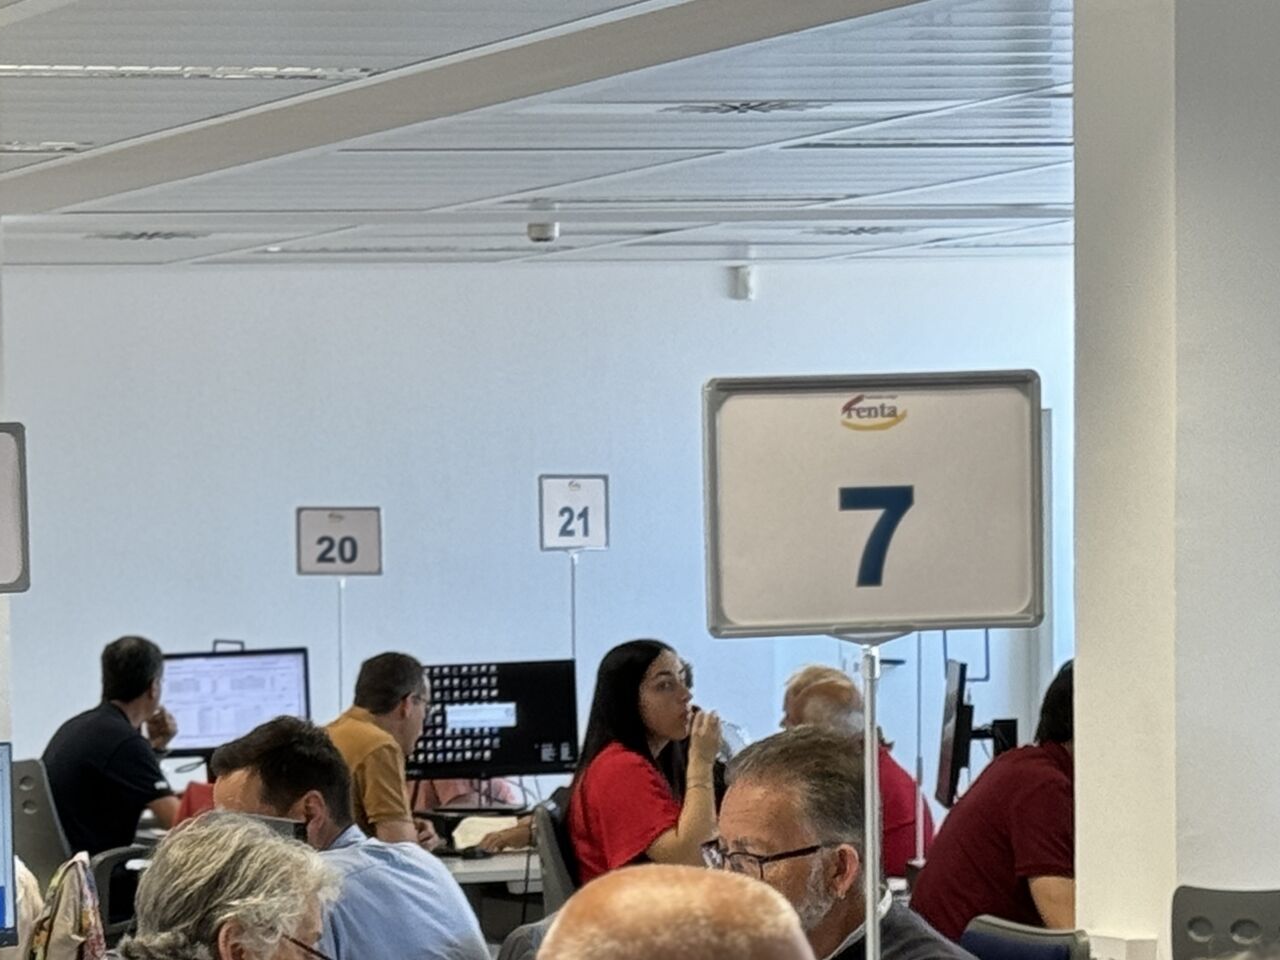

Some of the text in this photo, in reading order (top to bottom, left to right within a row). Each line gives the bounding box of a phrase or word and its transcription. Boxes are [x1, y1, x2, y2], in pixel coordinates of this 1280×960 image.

[844, 401, 898, 419] renta
[559, 506, 589, 537] 21
[840, 485, 914, 587] 7
[316, 536, 358, 564] 20
